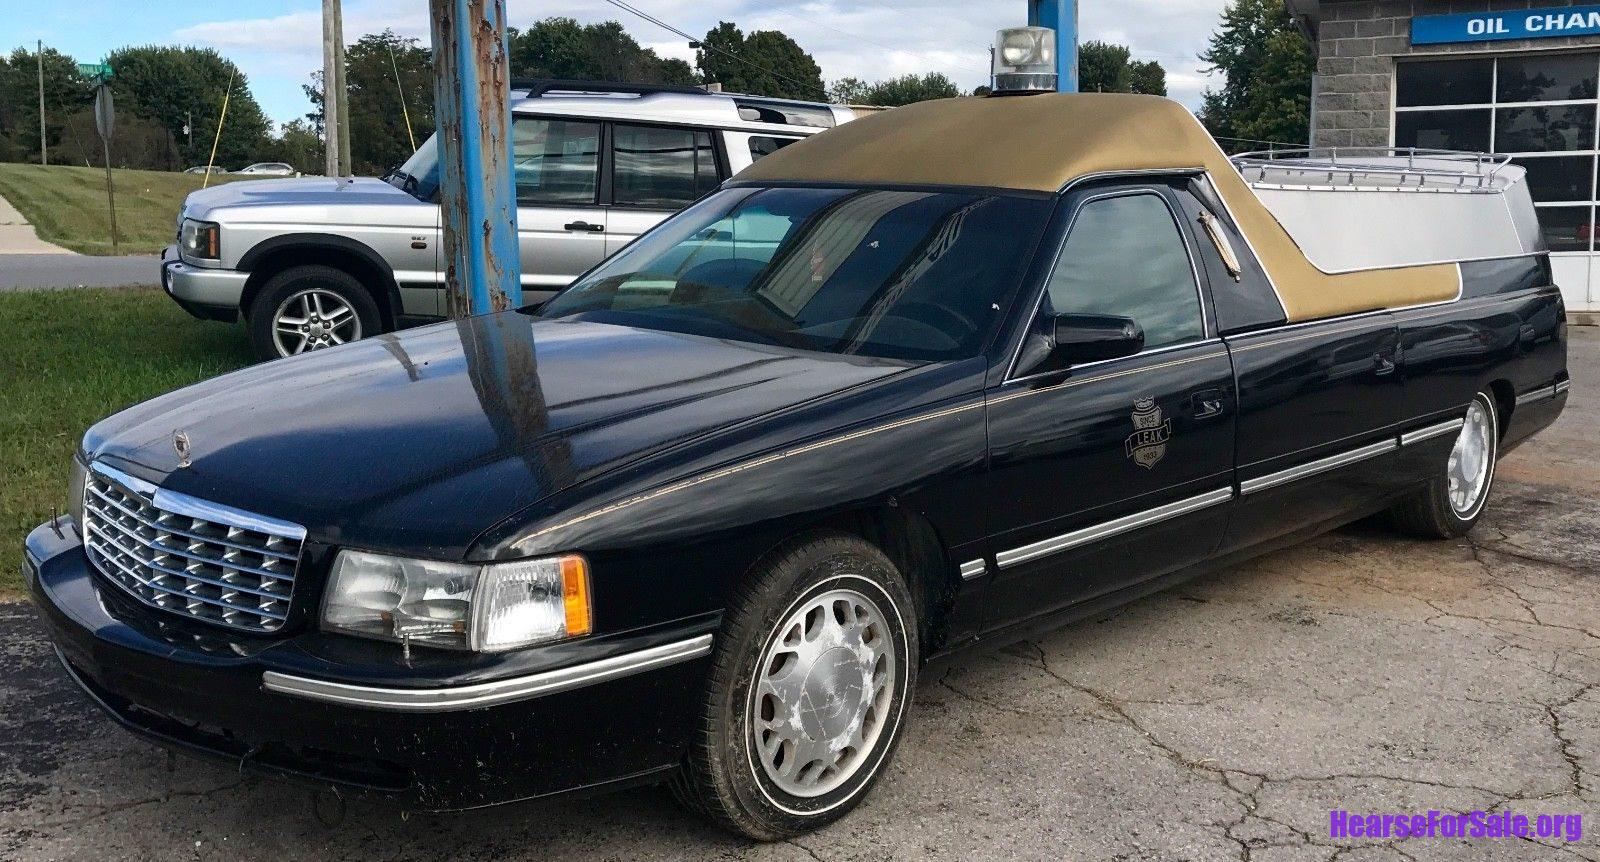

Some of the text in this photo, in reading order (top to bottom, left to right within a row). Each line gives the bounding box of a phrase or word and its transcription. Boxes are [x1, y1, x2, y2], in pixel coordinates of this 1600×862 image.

[1467, 17, 1509, 35] OIL
[1139, 414, 1156, 425] SINCE
[1137, 429, 1163, 445] LEAK
